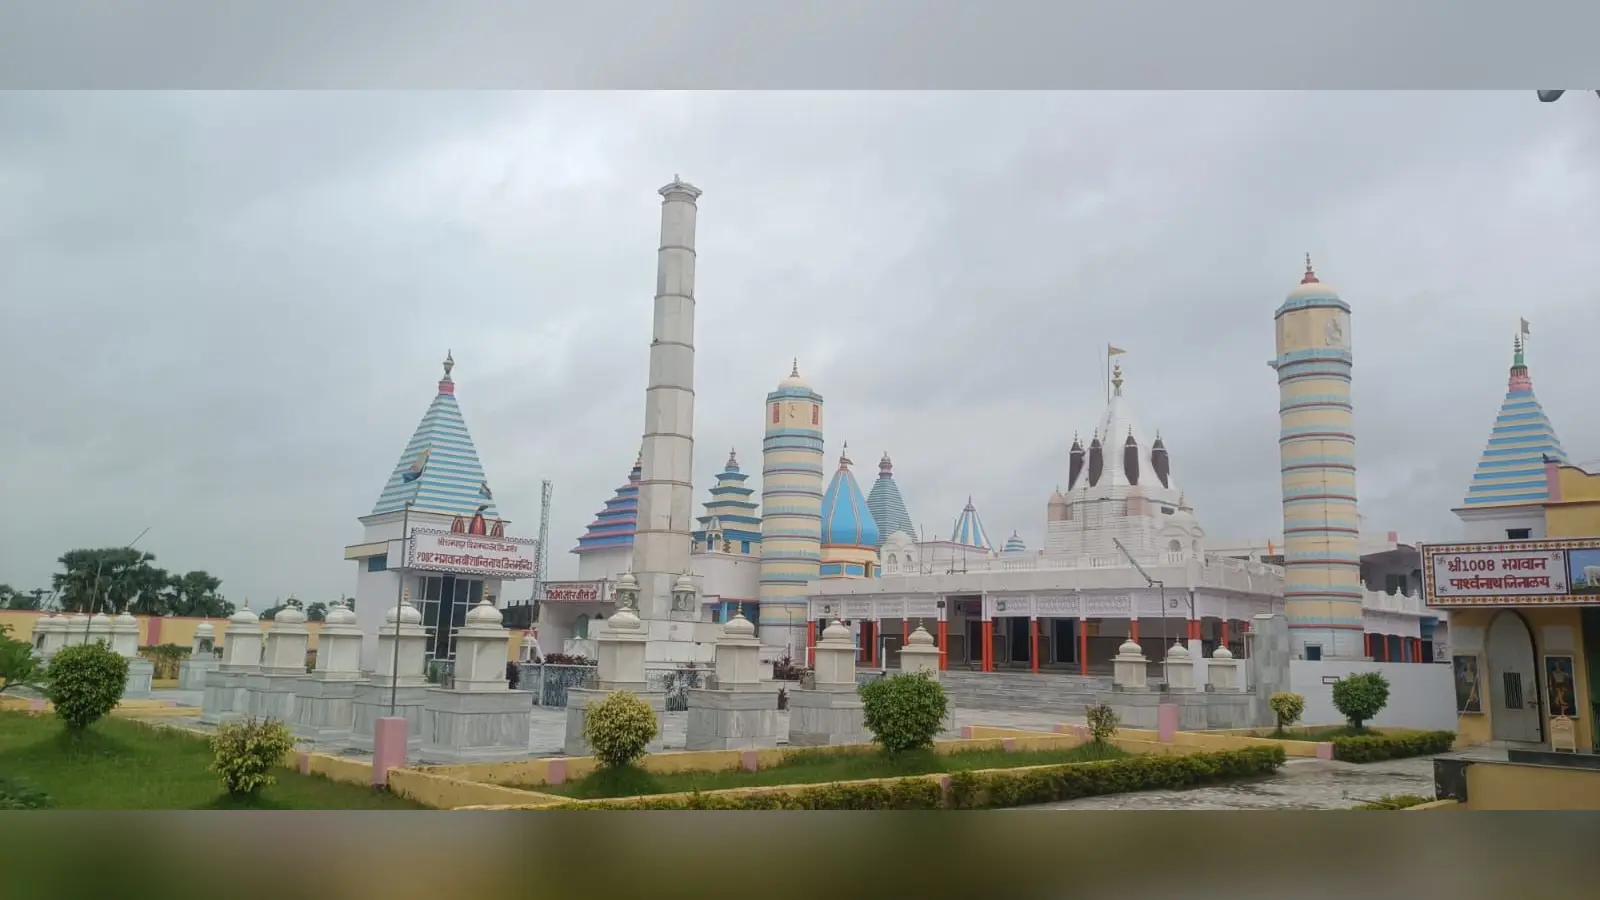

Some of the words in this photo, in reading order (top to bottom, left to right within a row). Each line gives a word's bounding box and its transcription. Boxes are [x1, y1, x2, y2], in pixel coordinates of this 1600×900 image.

[1501, 557, 1548, 571] भगवान
[1449, 574, 1503, 590] पार्श्वनाथ
[1503, 574, 1551, 590] जिनालय
